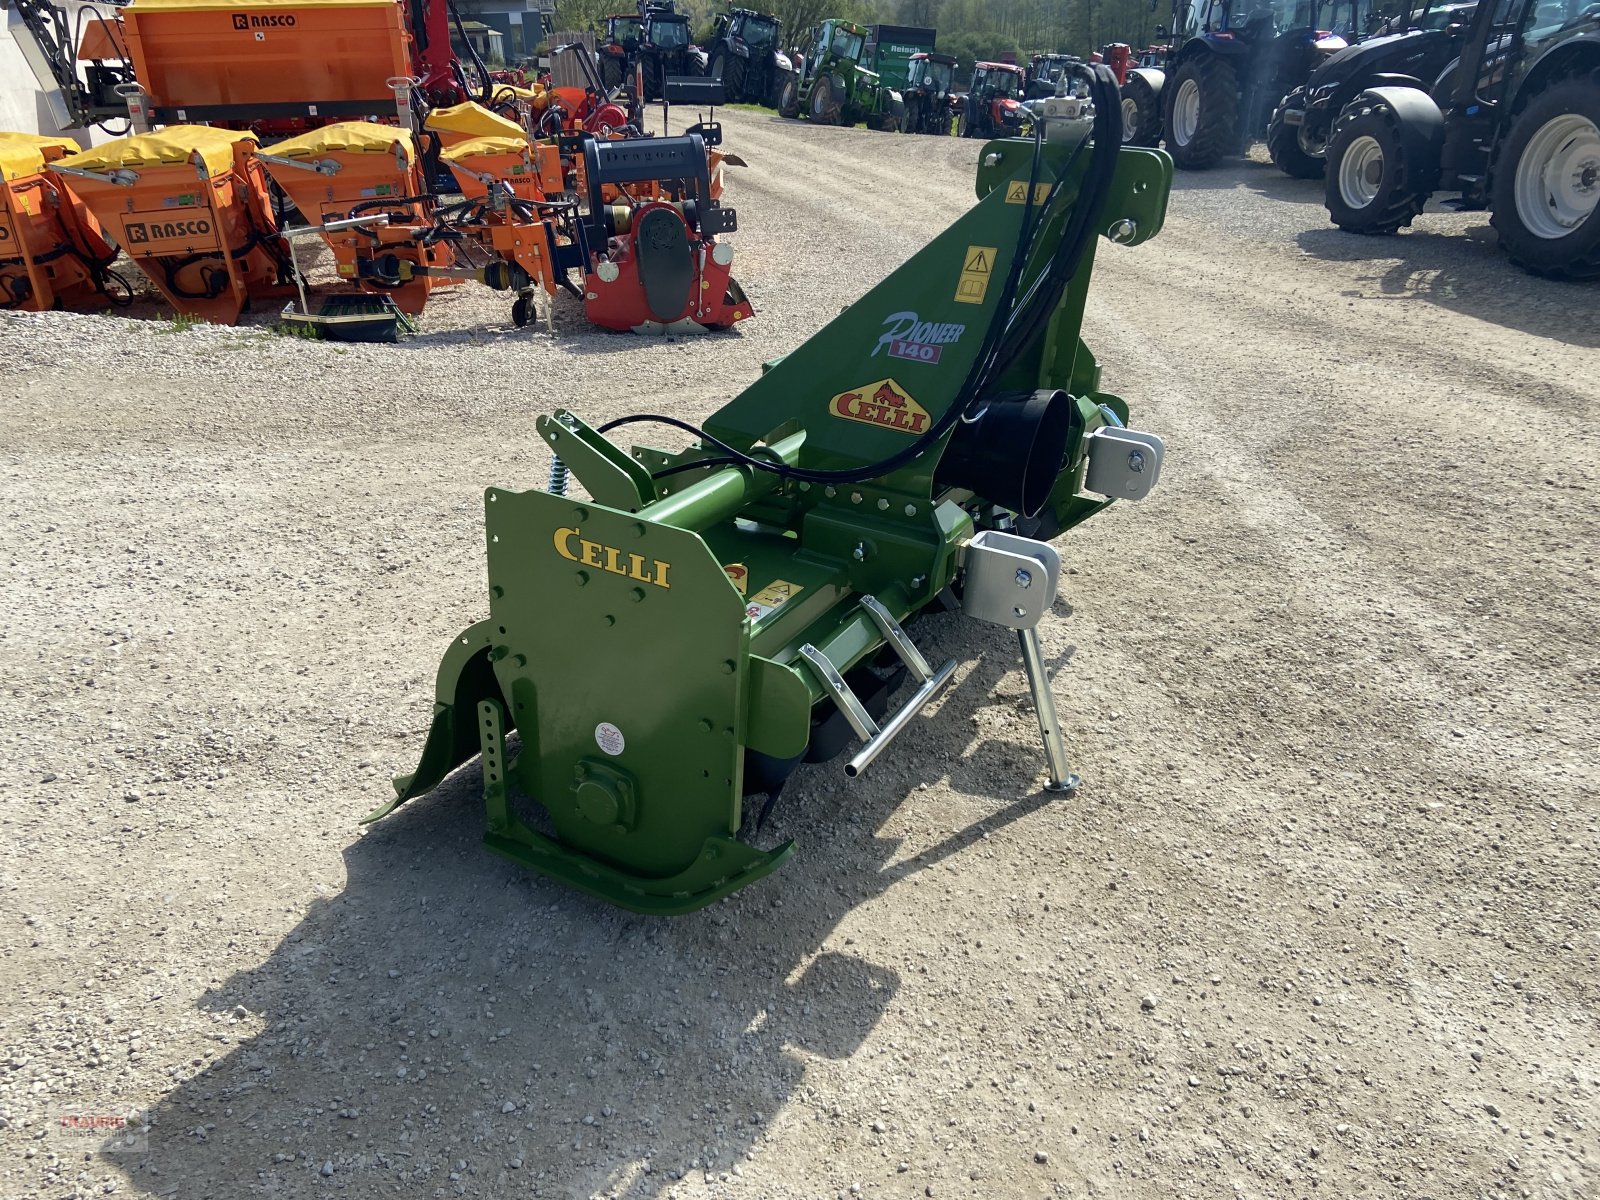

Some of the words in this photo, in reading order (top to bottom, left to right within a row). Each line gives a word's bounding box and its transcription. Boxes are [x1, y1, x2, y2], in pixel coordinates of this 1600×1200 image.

[251, 15, 295, 27] RASCO
[891, 45, 920, 53] Reisch
[150, 220, 210, 238] RASCO
[870, 311, 965, 358] PIONEER
[898, 342, 934, 359] 140
[836, 393, 927, 432] CELLI
[553, 527, 670, 588] CELLI
